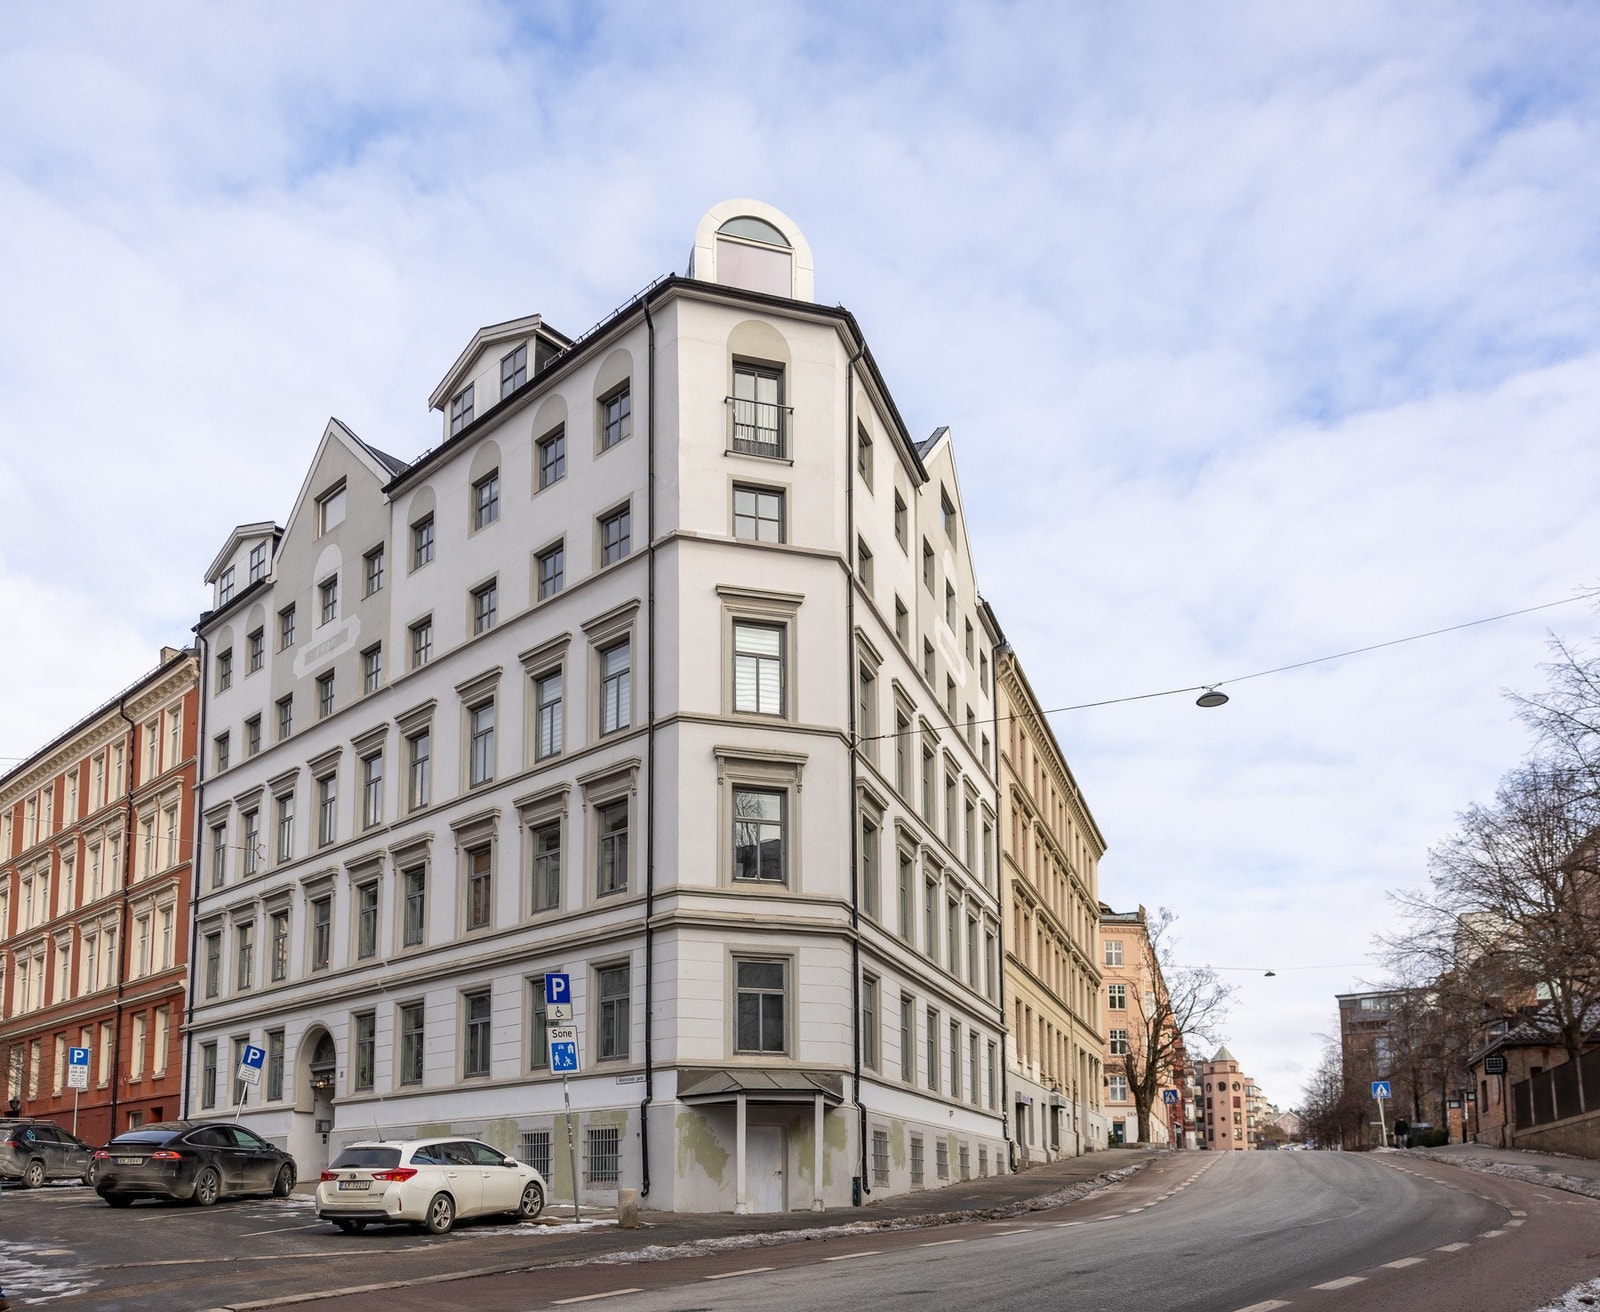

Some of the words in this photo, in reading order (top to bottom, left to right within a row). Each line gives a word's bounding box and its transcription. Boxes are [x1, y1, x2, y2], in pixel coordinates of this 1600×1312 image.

[552, 977, 566, 1001] P
[552, 1029, 573, 1038] Sone
[73, 1049, 84, 1063] P
[247, 1048, 261, 1063] P
